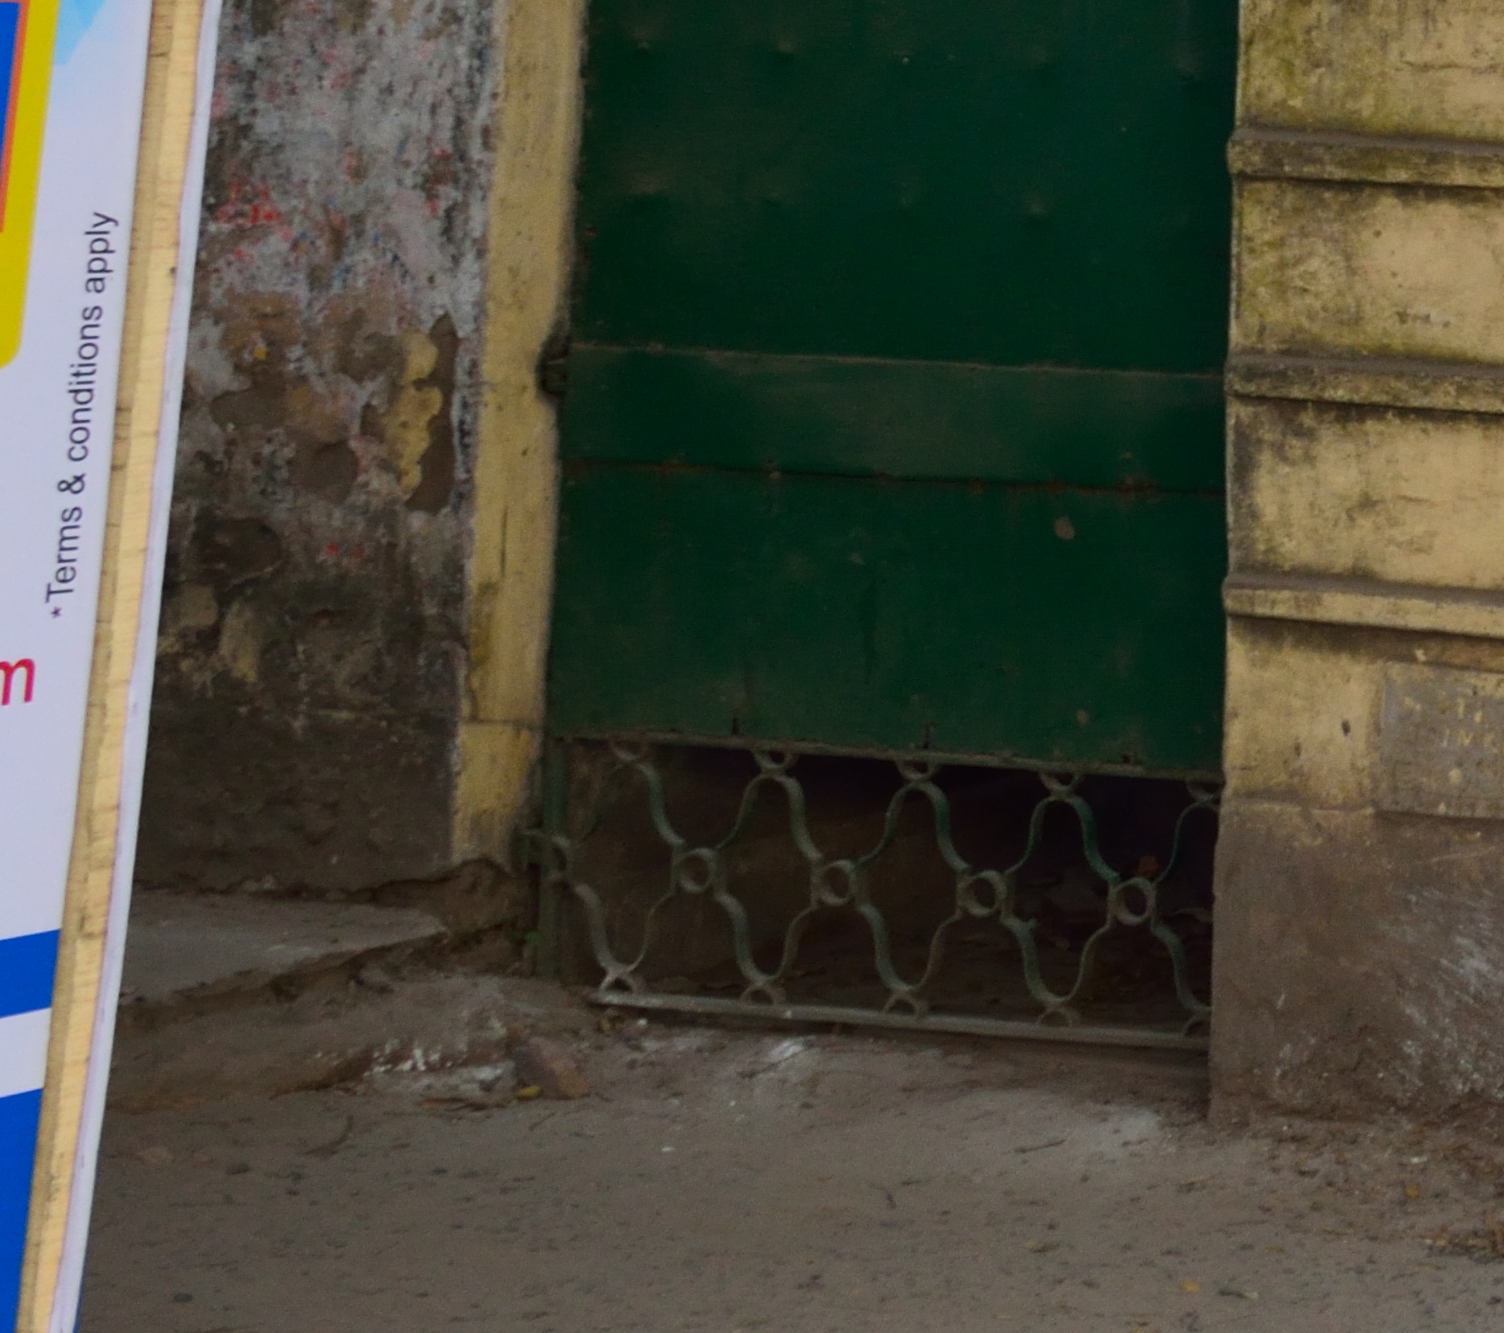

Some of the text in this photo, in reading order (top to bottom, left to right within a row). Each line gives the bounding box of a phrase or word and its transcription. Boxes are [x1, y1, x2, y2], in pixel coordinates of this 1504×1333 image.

[85, 211, 119, 295] apply
[58, 303, 104, 464] conditions
[58, 474, 87, 493] &
